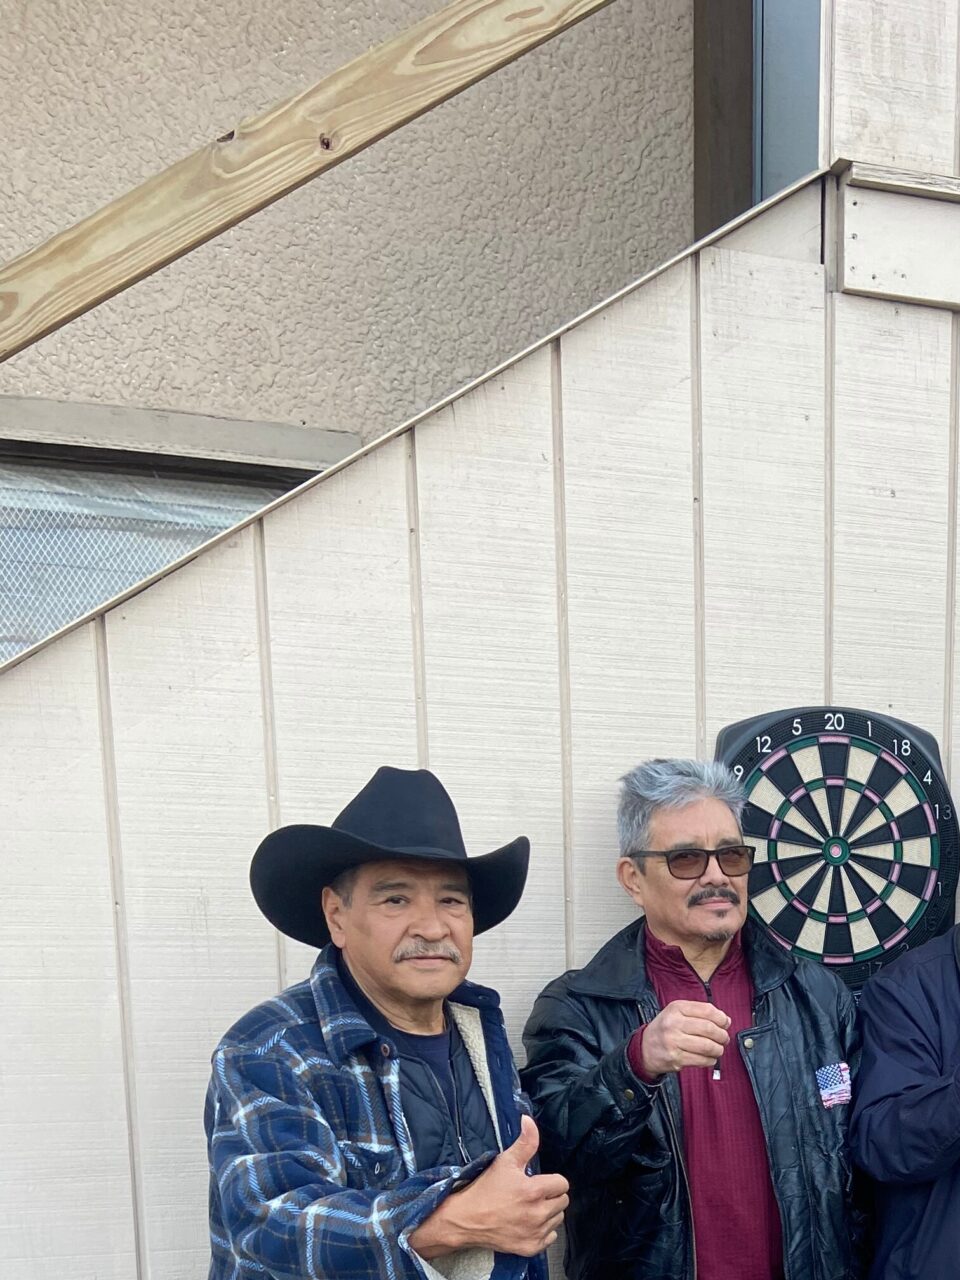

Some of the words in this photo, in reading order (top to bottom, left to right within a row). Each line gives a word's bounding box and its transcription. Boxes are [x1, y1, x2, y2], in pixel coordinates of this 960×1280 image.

[792, 719, 802, 735] 5
[824, 713, 845, 730] 20
[866, 721, 872, 737] 1
[756, 736, 772, 752] 12
[893, 739, 911, 756] 18
[733, 765, 744, 781] 9
[923, 770, 932, 785] 4
[935, 803, 951, 820] 13
